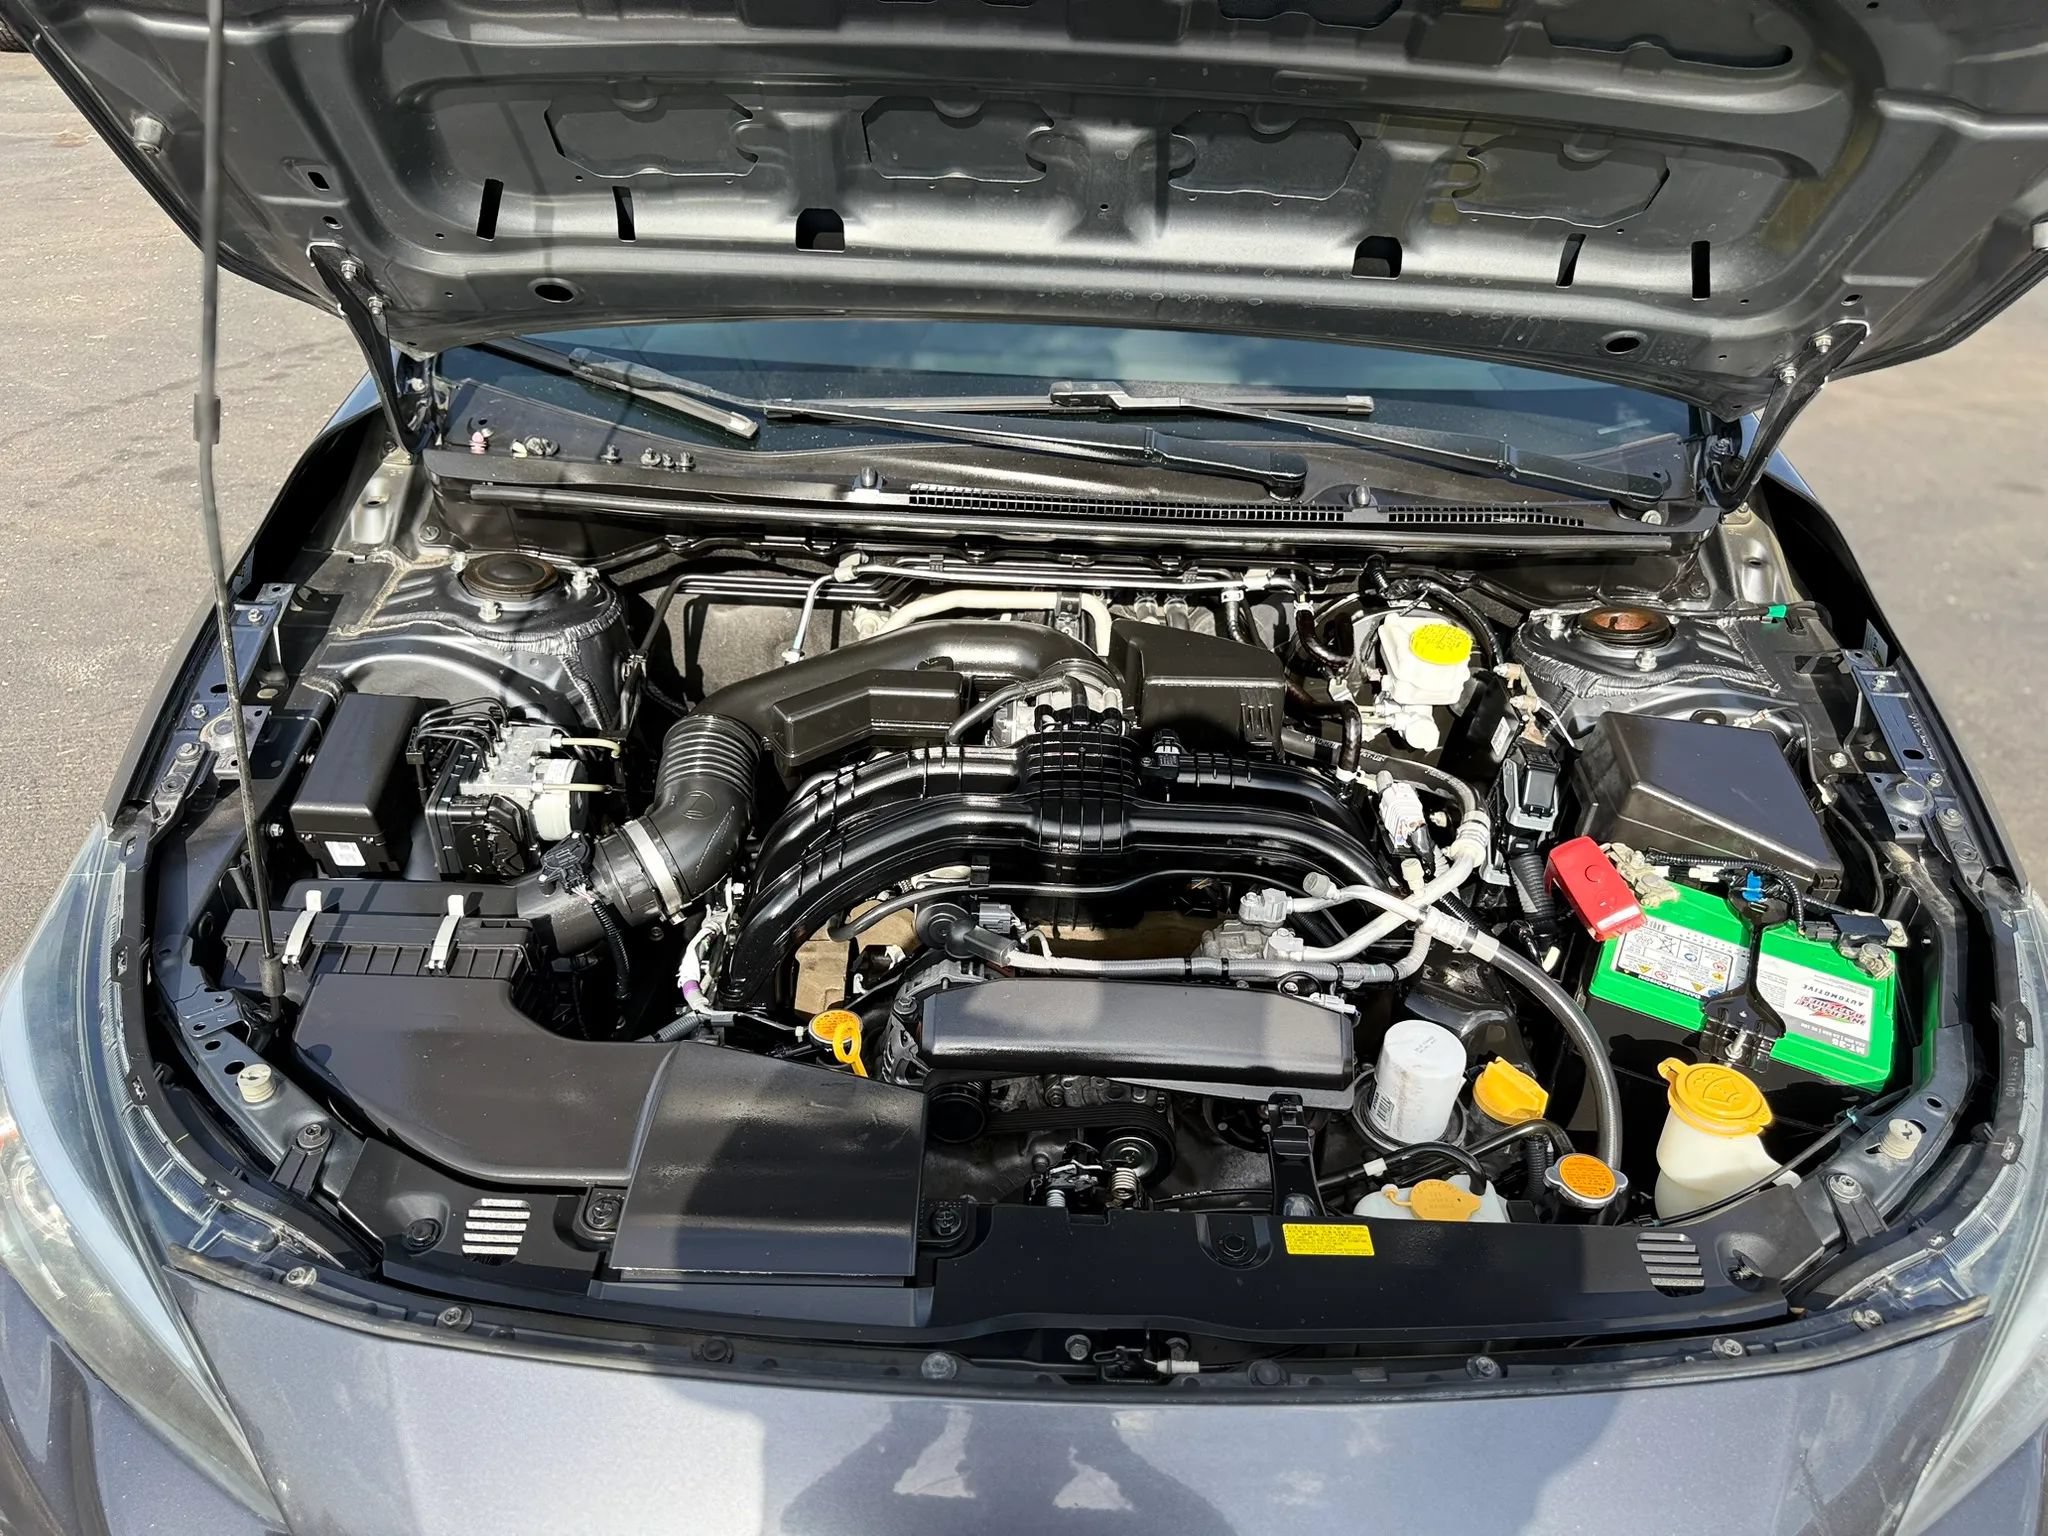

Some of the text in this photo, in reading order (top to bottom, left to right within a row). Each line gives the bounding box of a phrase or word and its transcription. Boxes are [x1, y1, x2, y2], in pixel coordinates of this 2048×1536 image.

[1802, 984, 1864, 1007] AUTOMOTIVE
[1795, 999, 1866, 1025] INTERSTATE
[1801, 996, 1865, 1019] BATTERIES
[1832, 1037, 1866, 1056] MT-35
